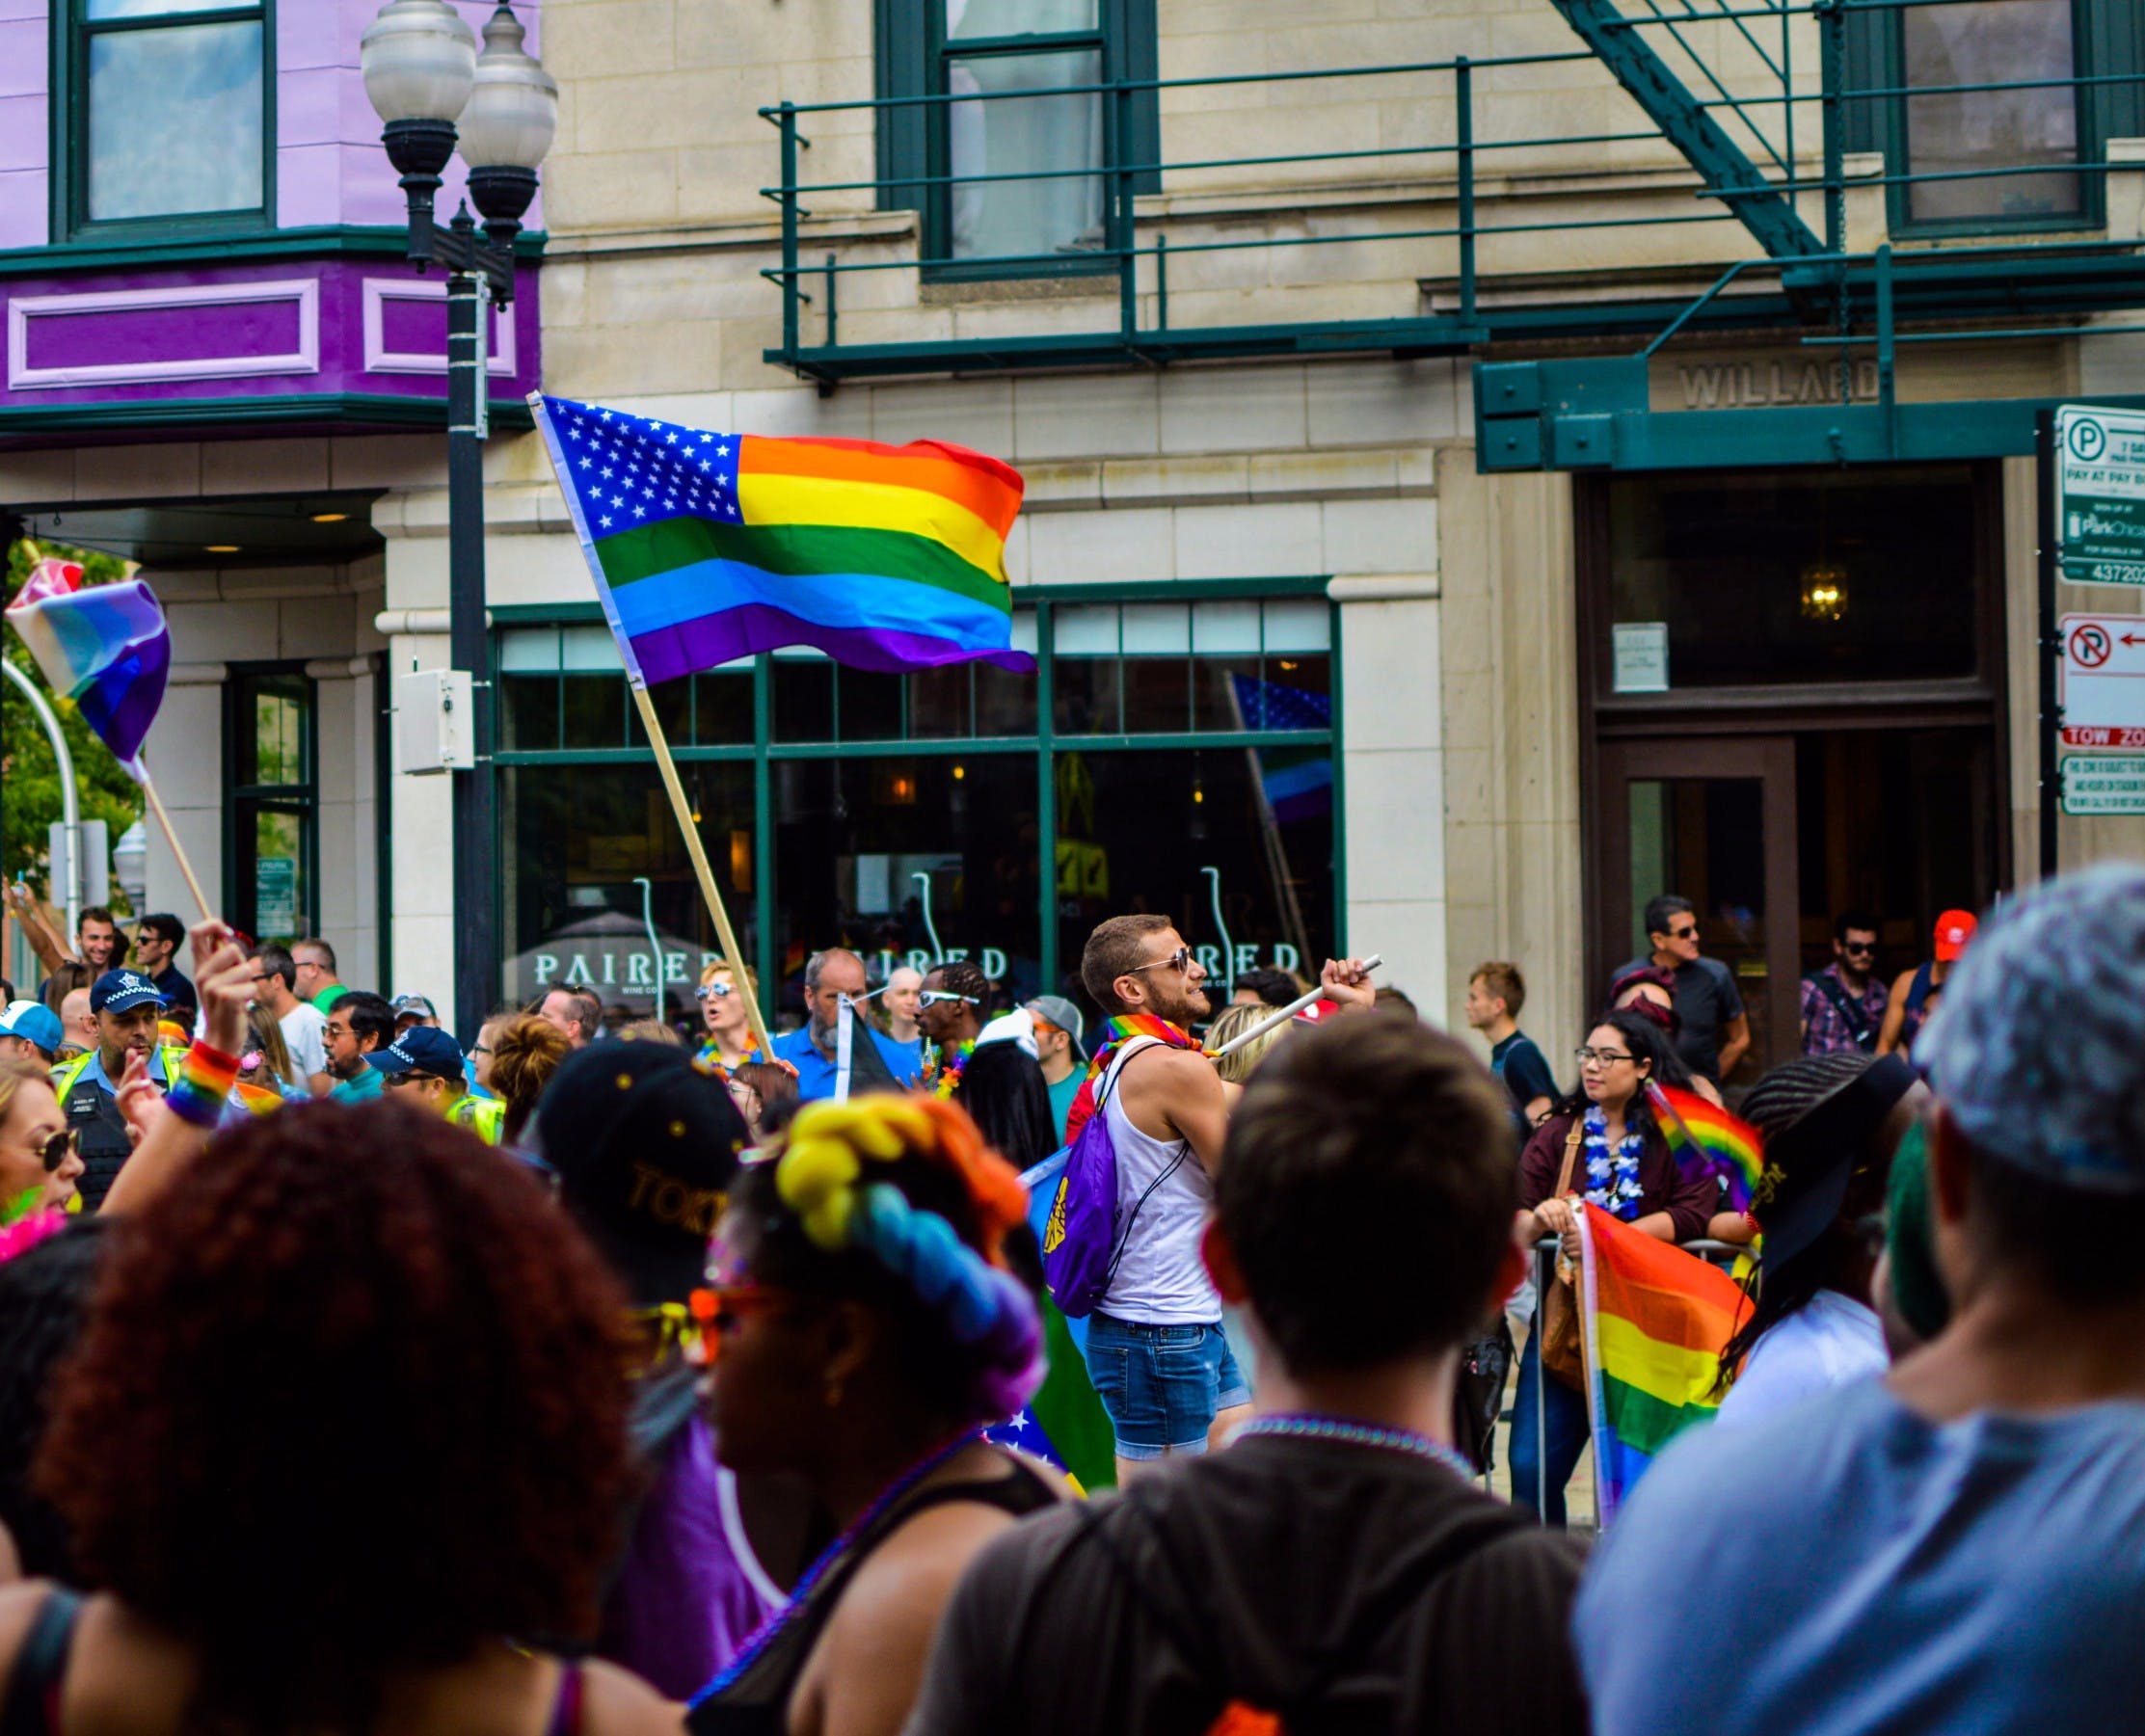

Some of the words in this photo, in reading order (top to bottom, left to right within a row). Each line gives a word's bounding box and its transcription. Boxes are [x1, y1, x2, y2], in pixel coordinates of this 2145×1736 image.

[1679, 359, 1879, 408] WILLARD
[2067, 469, 2088, 479] PAY
[2069, 728, 2109, 744] TOW
[621, 986, 644, 995] WINE
